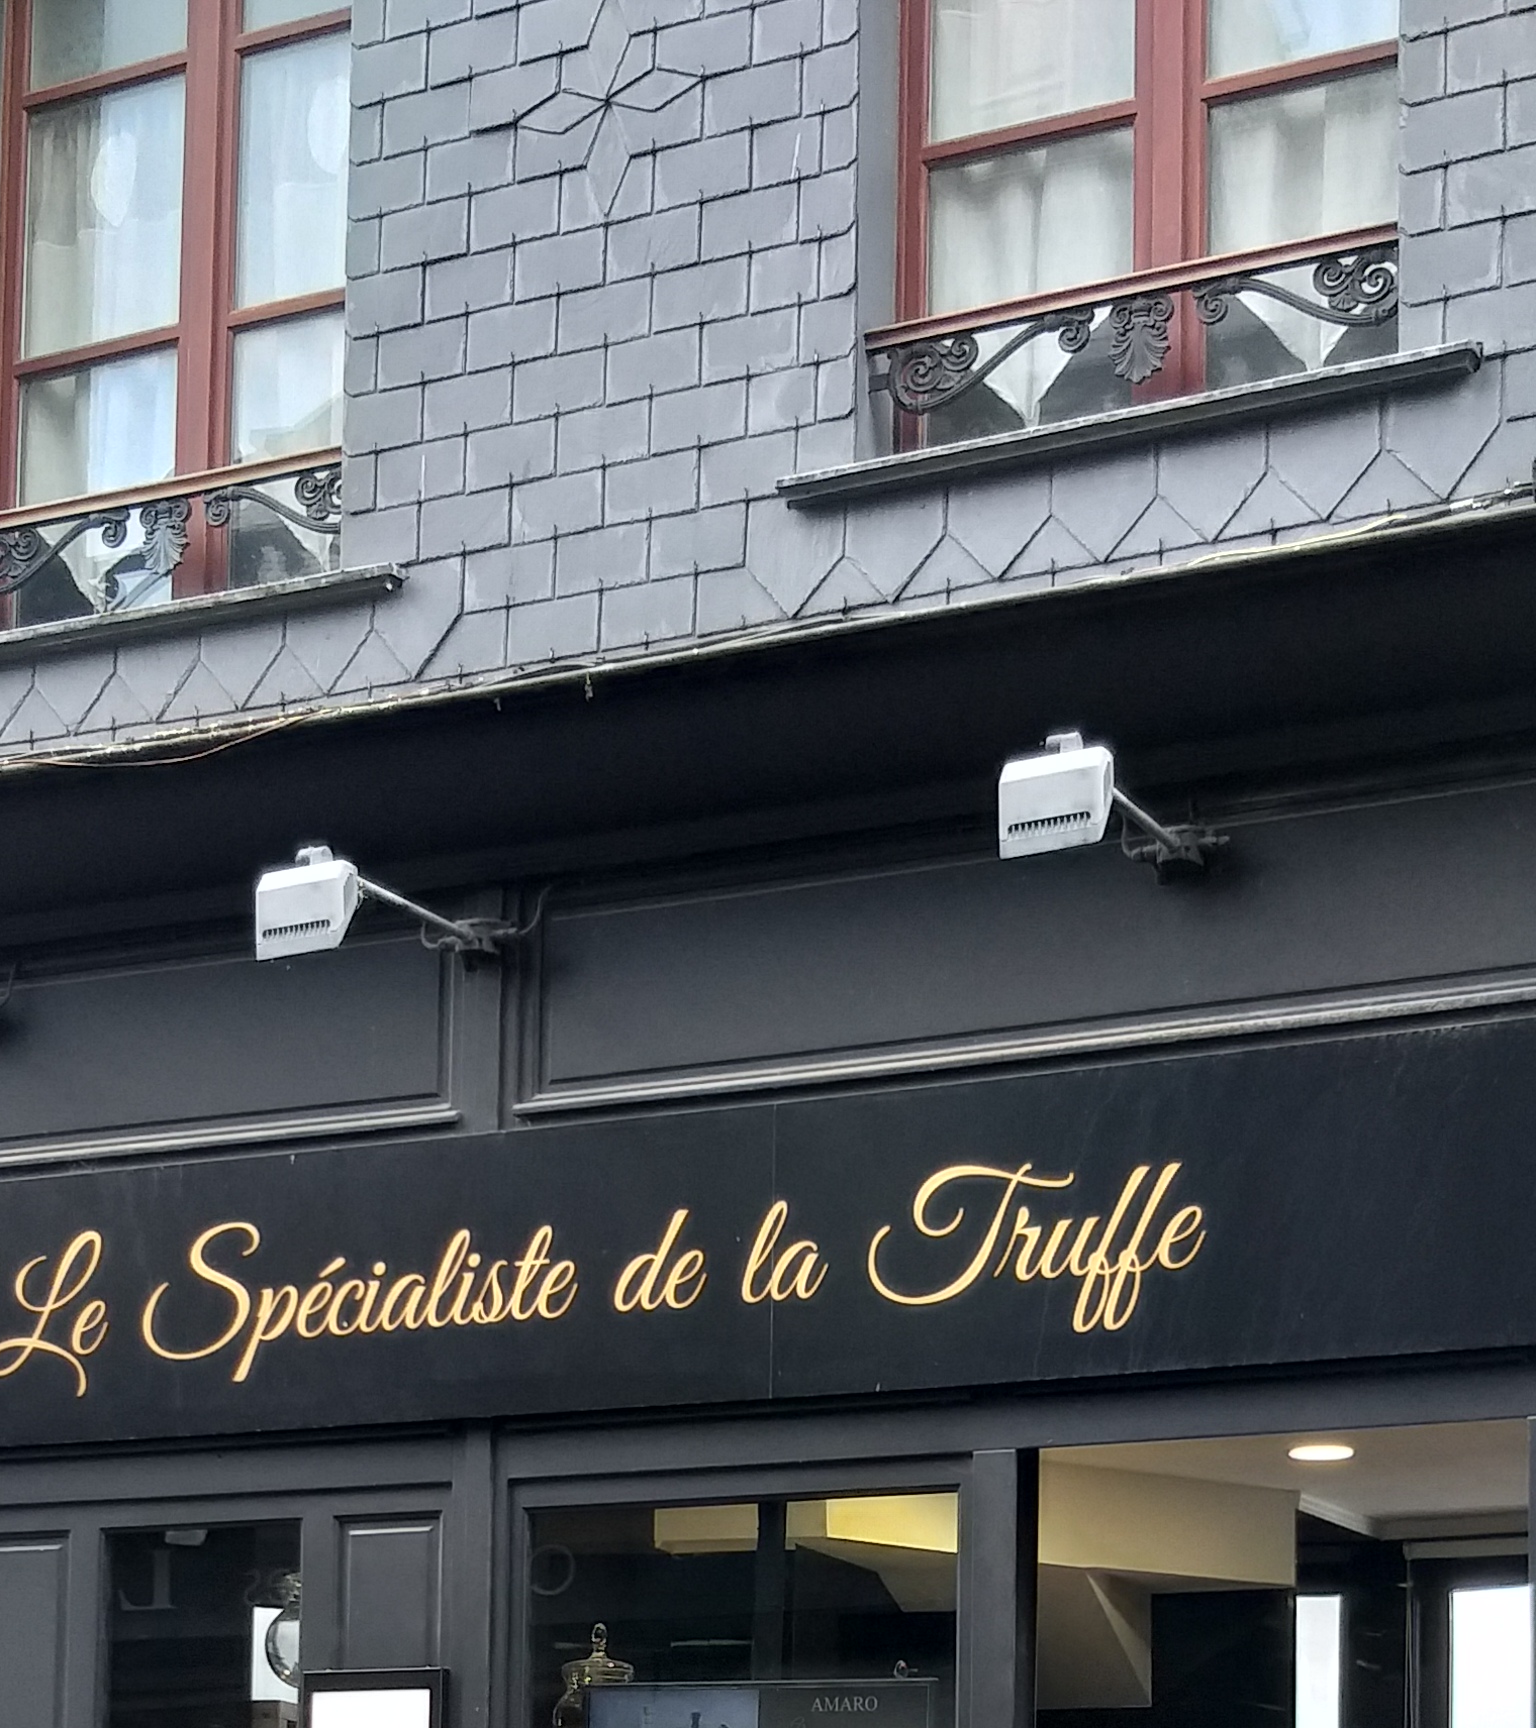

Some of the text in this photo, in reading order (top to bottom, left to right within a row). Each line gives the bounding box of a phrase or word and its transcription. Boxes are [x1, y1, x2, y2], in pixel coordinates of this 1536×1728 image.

[142, 1221, 579, 1383] Spécialiste
[613, 1208, 707, 1312] de
[741, 1199, 829, 1304] la
[868, 1162, 1208, 1334] Truffe
[810, 1696, 879, 1713] AMARO
